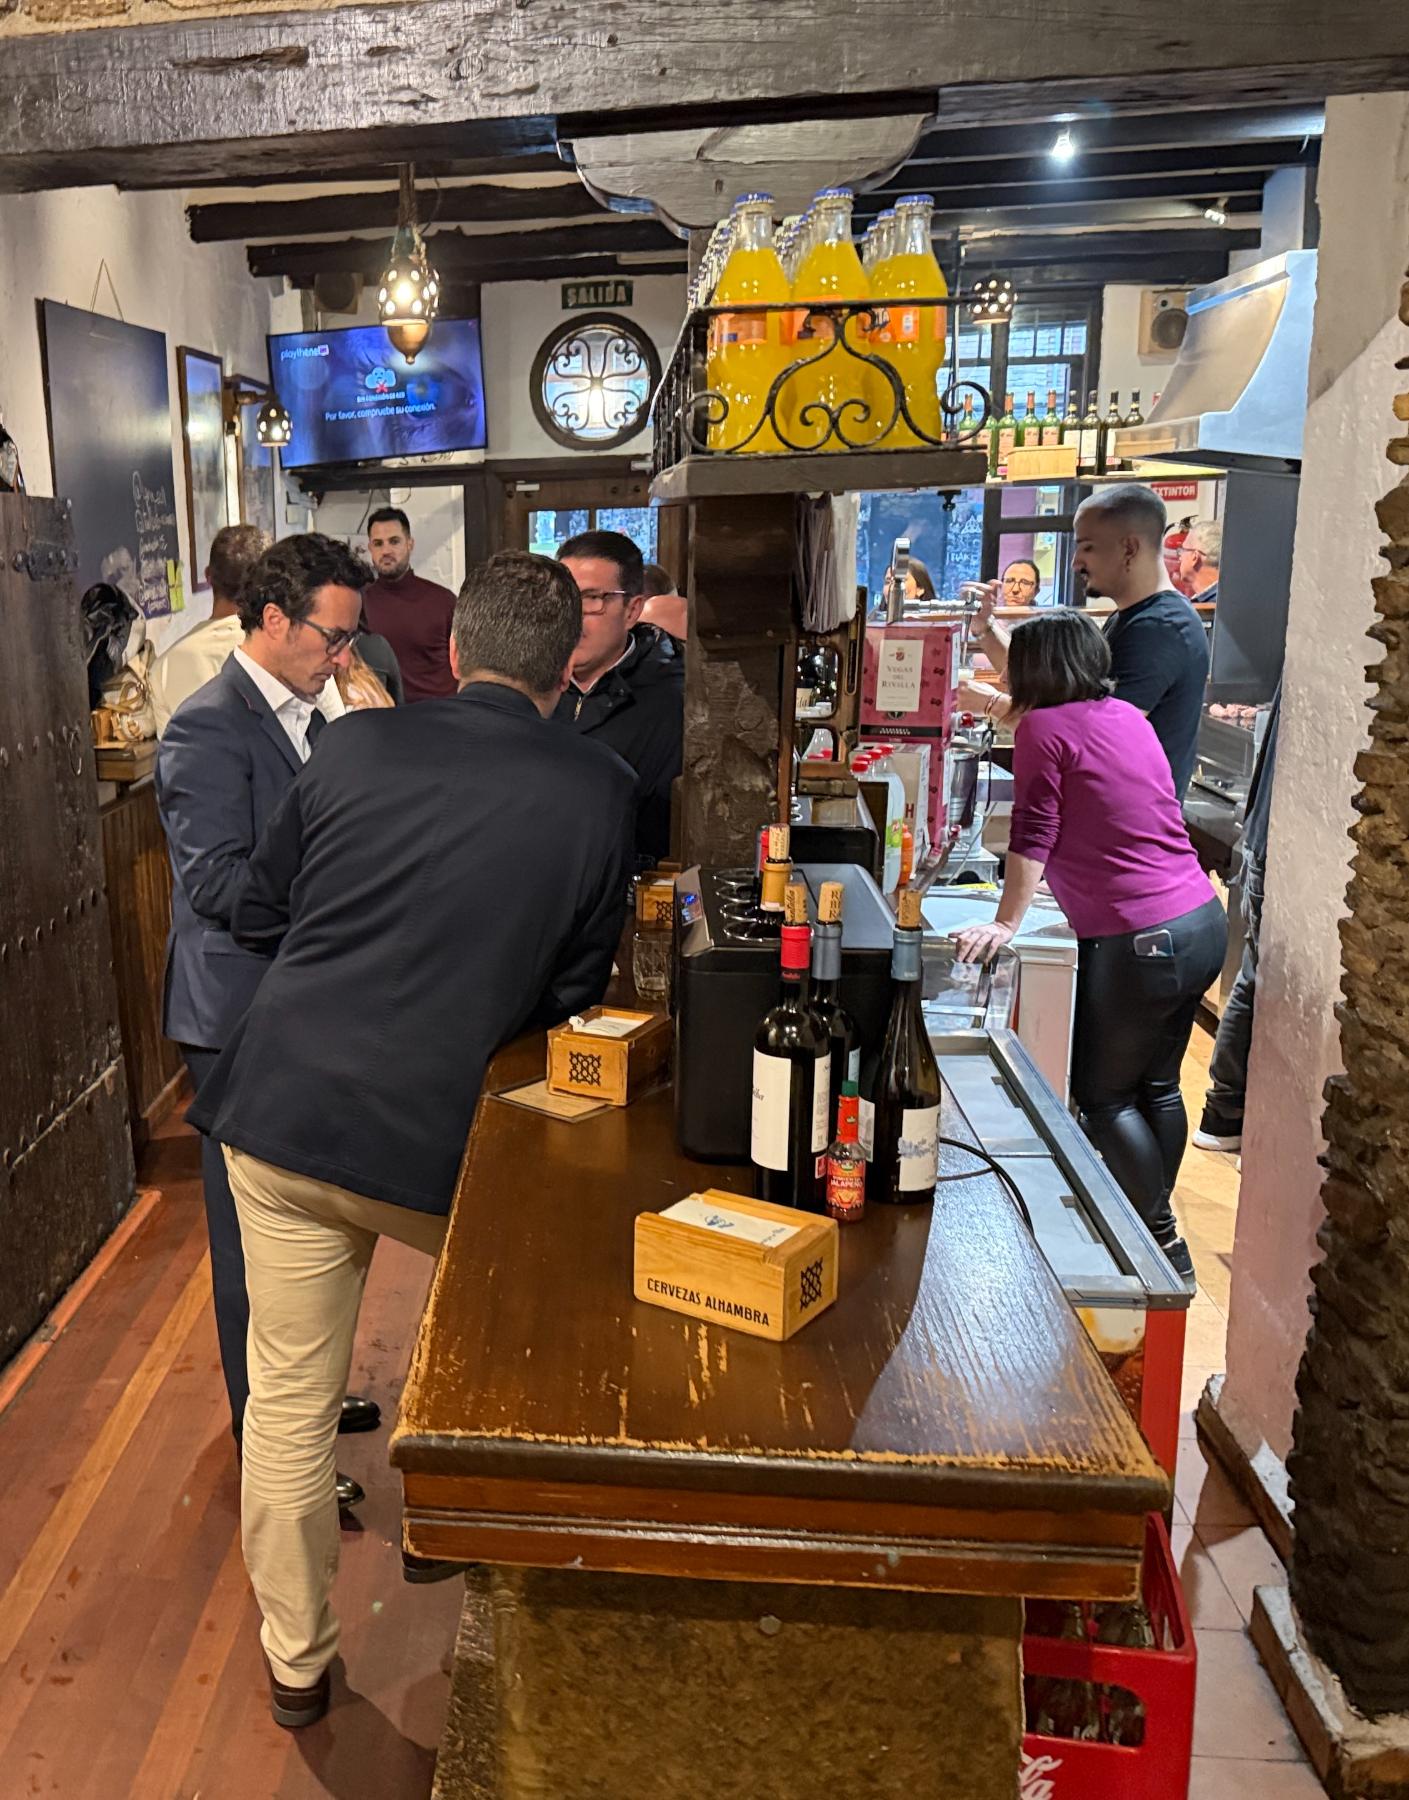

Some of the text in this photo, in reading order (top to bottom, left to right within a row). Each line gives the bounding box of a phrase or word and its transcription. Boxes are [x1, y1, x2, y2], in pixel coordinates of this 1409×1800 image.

[567, 285, 627, 305] SALIDA
[325, 412, 337, 421] Por
[357, 407, 395, 418] compruebe
[395, 406, 404, 414] su
[647, 1277, 701, 1306] CERVEZAS
[705, 1295, 770, 1327] ALHAMBRA
